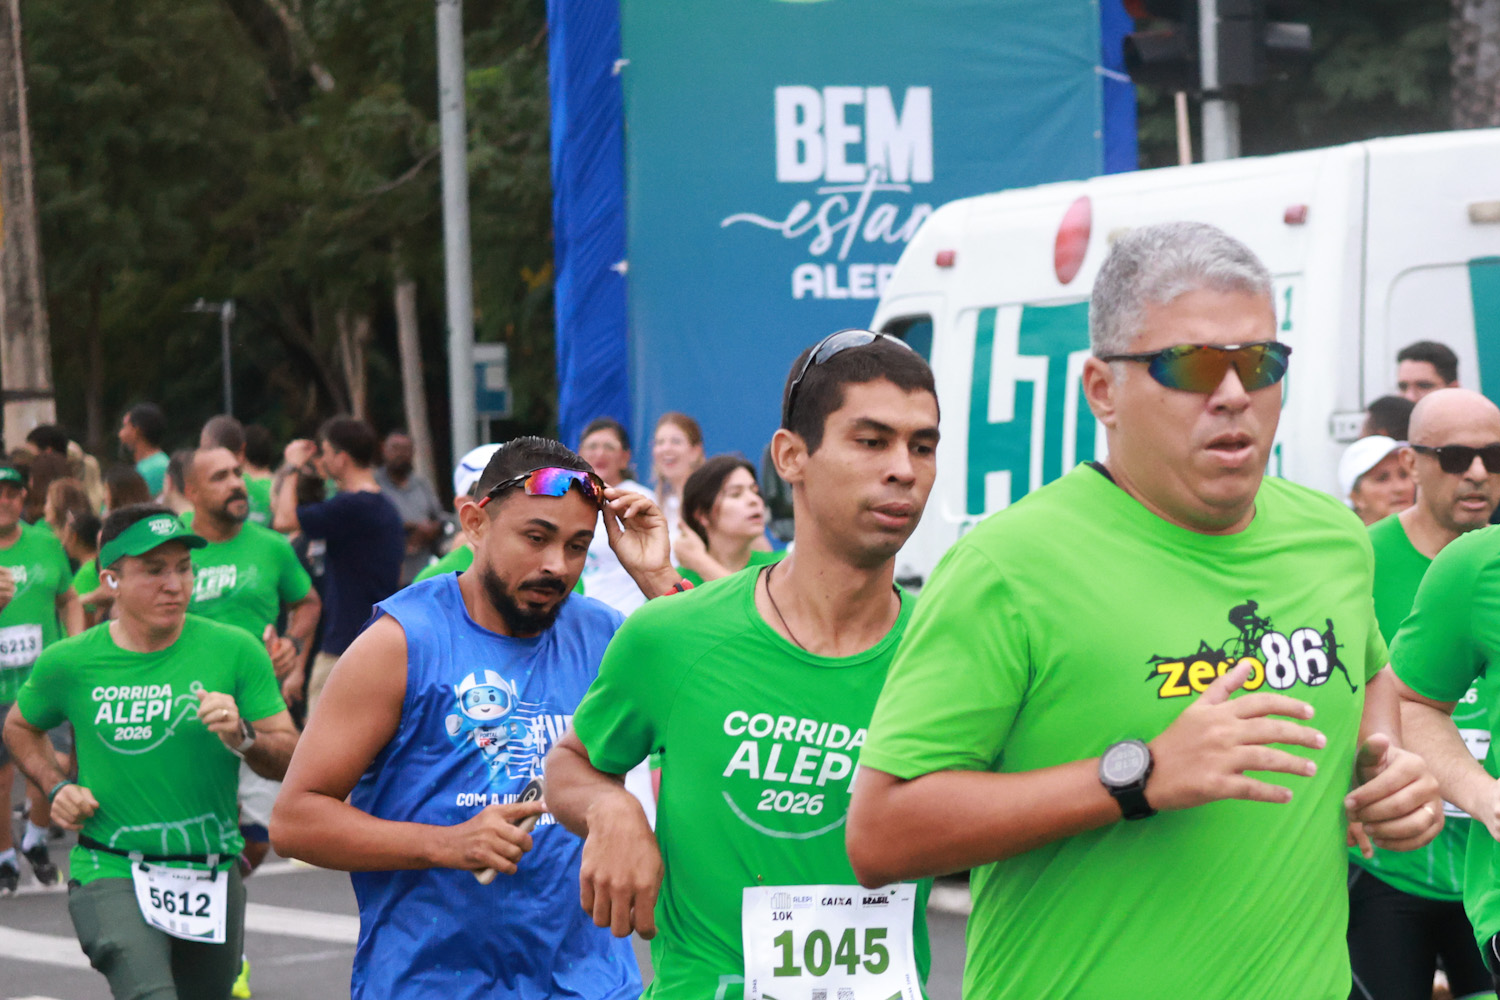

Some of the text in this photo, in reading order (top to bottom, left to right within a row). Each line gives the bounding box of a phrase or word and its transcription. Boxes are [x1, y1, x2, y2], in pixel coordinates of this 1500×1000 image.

[774, 85, 934, 183] BEM
[192, 574, 237, 594] LEPI
[92, 683, 173, 701] CORRIDA
[94, 699, 173, 725] ALEPI
[114, 725, 152, 741] 2026
[723, 710, 868, 751] CORRIDA
[456, 792, 487, 808] COM
[757, 788, 825, 816] 2026
[149, 886, 211, 918] 5612
[821, 897, 853, 906] CAIXA
[772, 911, 793, 921] 10K
[772, 927, 890, 977] 1045
